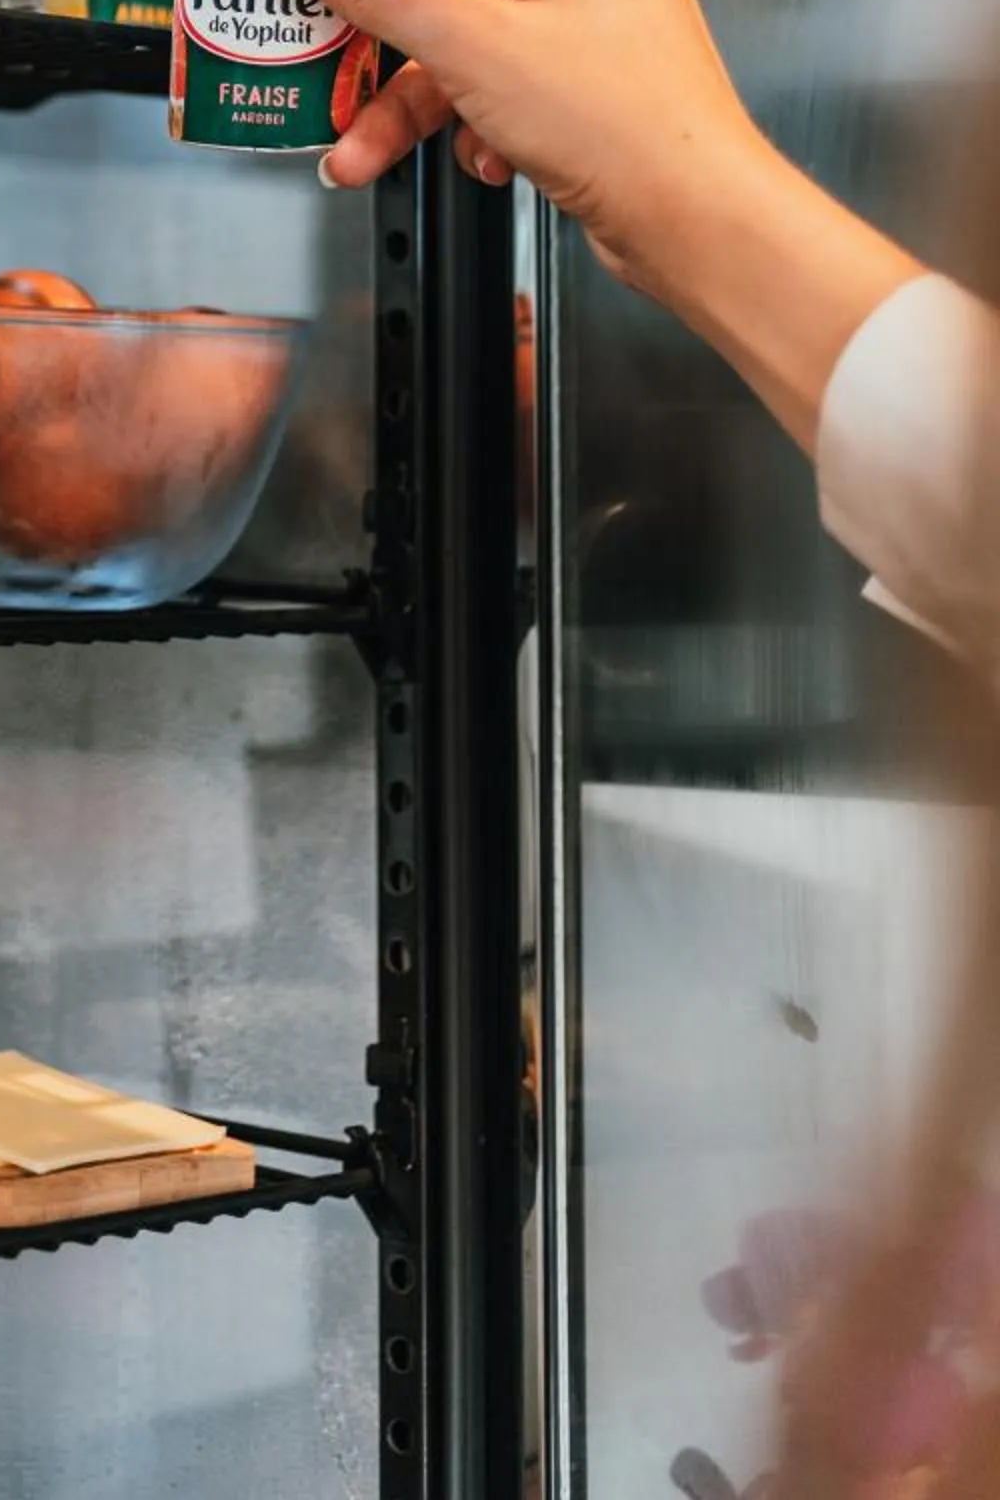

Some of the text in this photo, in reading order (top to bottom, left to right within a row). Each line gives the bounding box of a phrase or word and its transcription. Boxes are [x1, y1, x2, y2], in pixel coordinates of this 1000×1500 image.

[209, 15, 315, 47] de Yoplait
[218, 83, 299, 109] FRAISE
